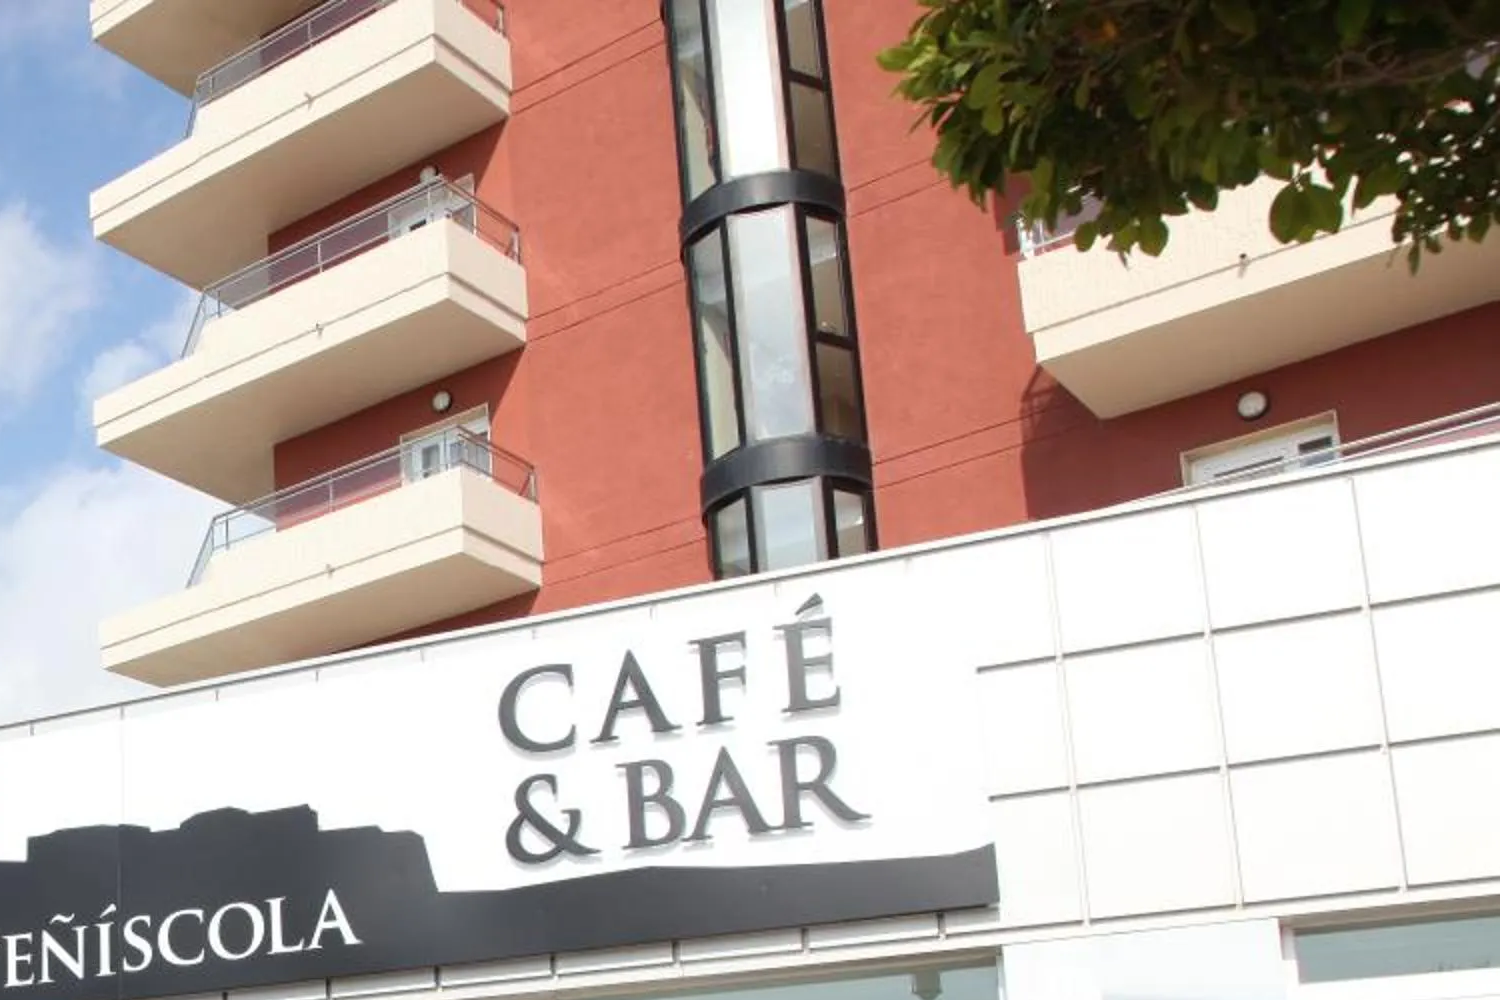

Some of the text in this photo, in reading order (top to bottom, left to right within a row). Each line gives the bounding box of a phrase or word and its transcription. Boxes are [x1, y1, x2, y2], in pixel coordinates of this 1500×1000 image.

[498, 593, 841, 752] CAFÉ
[505, 735, 872, 863] & BAR
